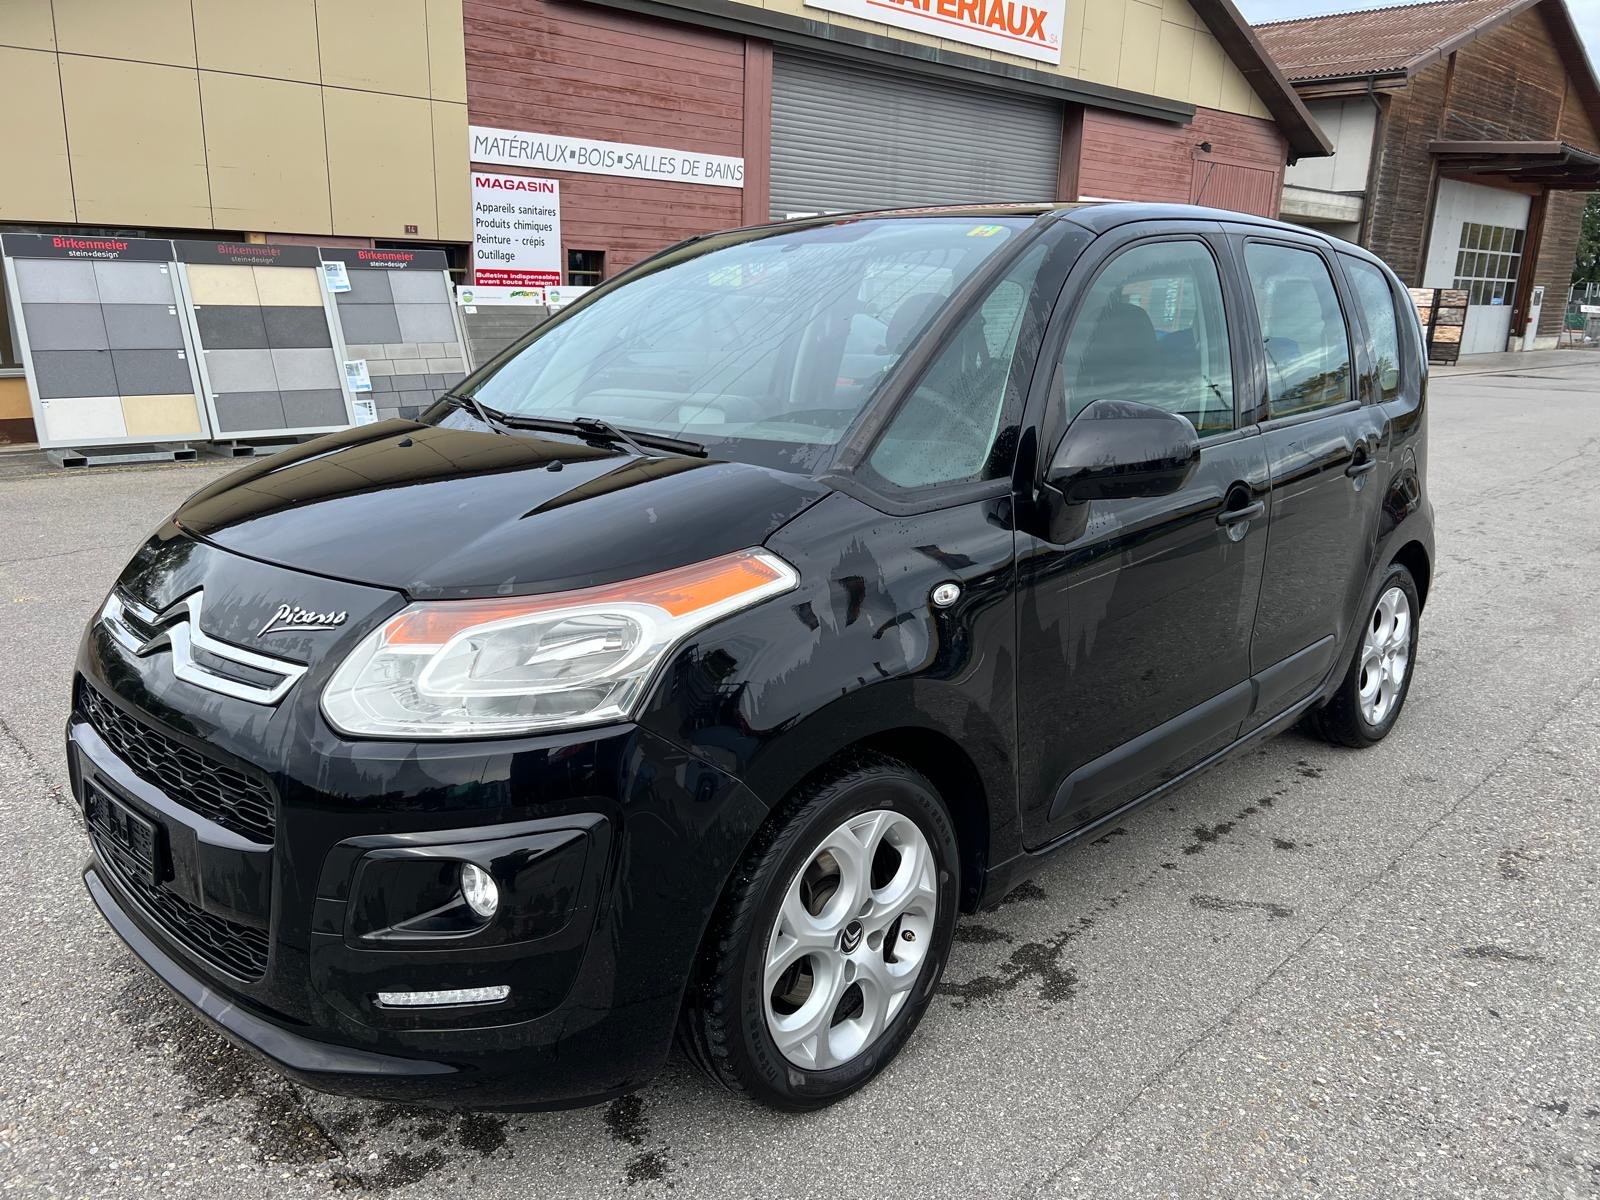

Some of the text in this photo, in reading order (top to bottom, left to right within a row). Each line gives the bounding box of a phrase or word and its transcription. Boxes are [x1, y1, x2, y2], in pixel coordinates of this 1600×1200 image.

[474, 135, 744, 181] MATÉRIAUX BOIS SALLES DE BAINS
[475, 177, 554, 193] MAGASIN
[475, 202, 557, 217] Appareils sanitaires
[475, 218, 553, 233] Produits chimiques
[52, 237, 128, 250] Birkenmeier
[476, 233, 511, 245] Peinture
[522, 236, 545, 248] crépis
[217, 244, 281, 256] Birkenmeier
[357, 250, 414, 261] Birkenmeier
[477, 249, 516, 262] Outillage
[256, 604, 347, 637] Picasso
